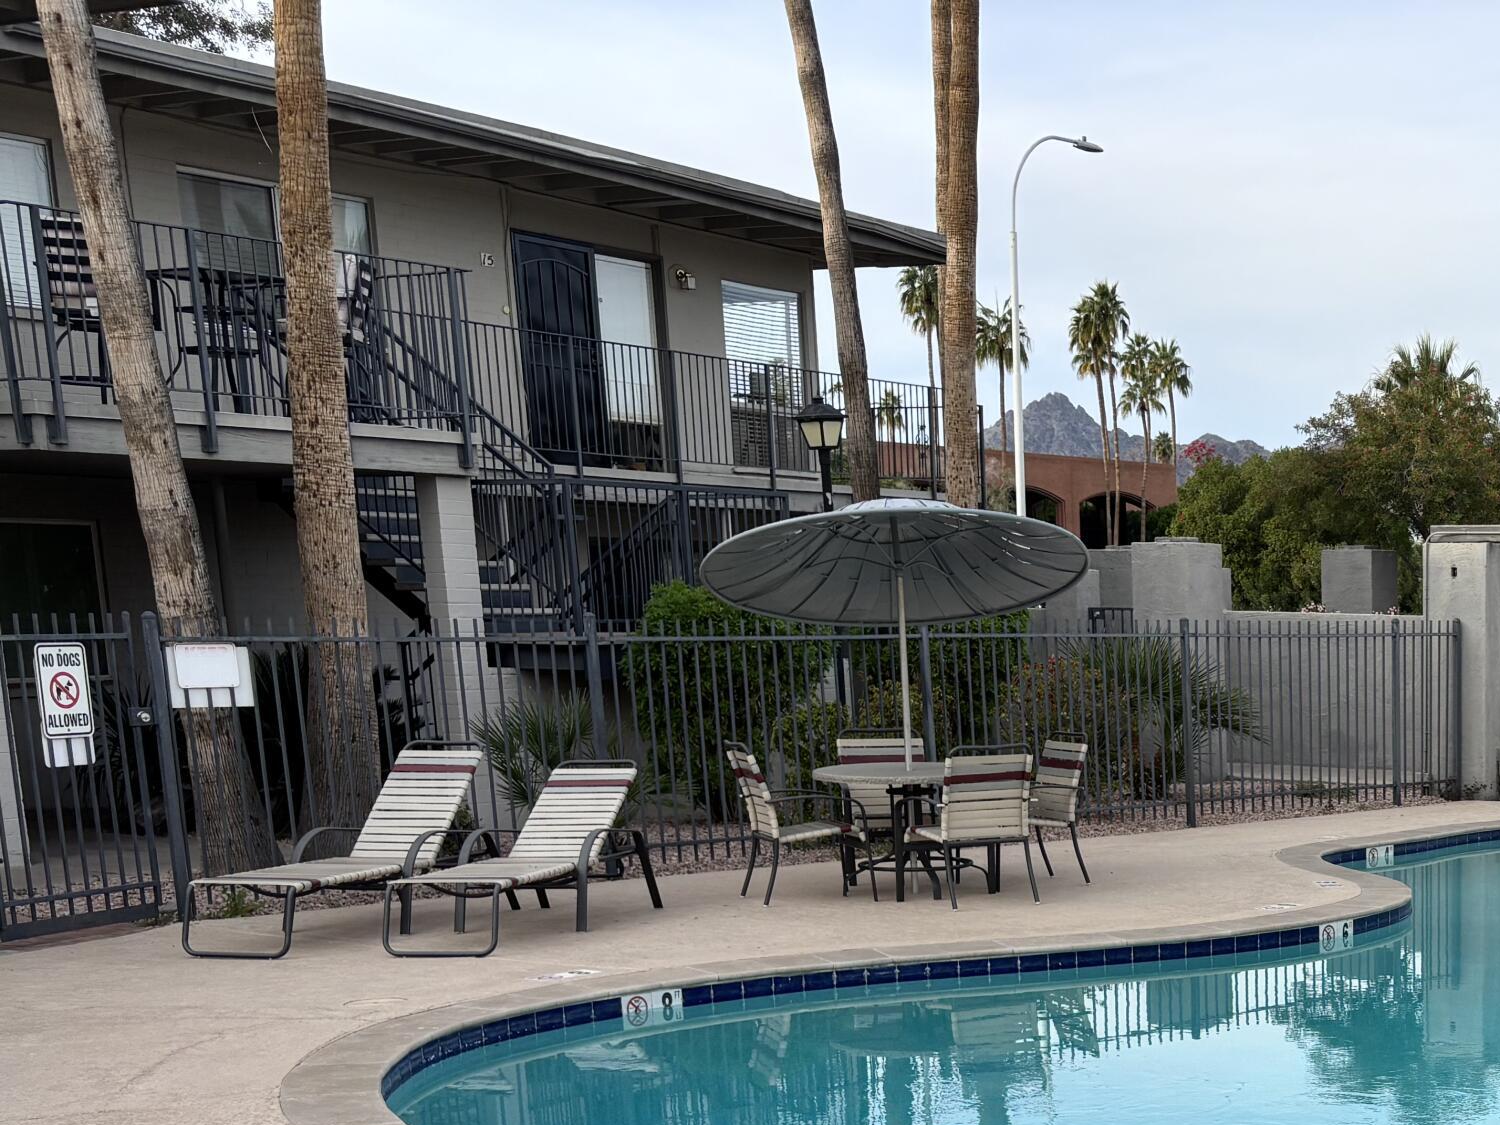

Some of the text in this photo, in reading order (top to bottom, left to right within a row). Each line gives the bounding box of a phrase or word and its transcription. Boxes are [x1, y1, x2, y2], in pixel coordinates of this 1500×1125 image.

[482, 254, 494, 266] 15
[41, 653, 81, 667] NO DOGS
[48, 713, 89, 728] ALLOWED
